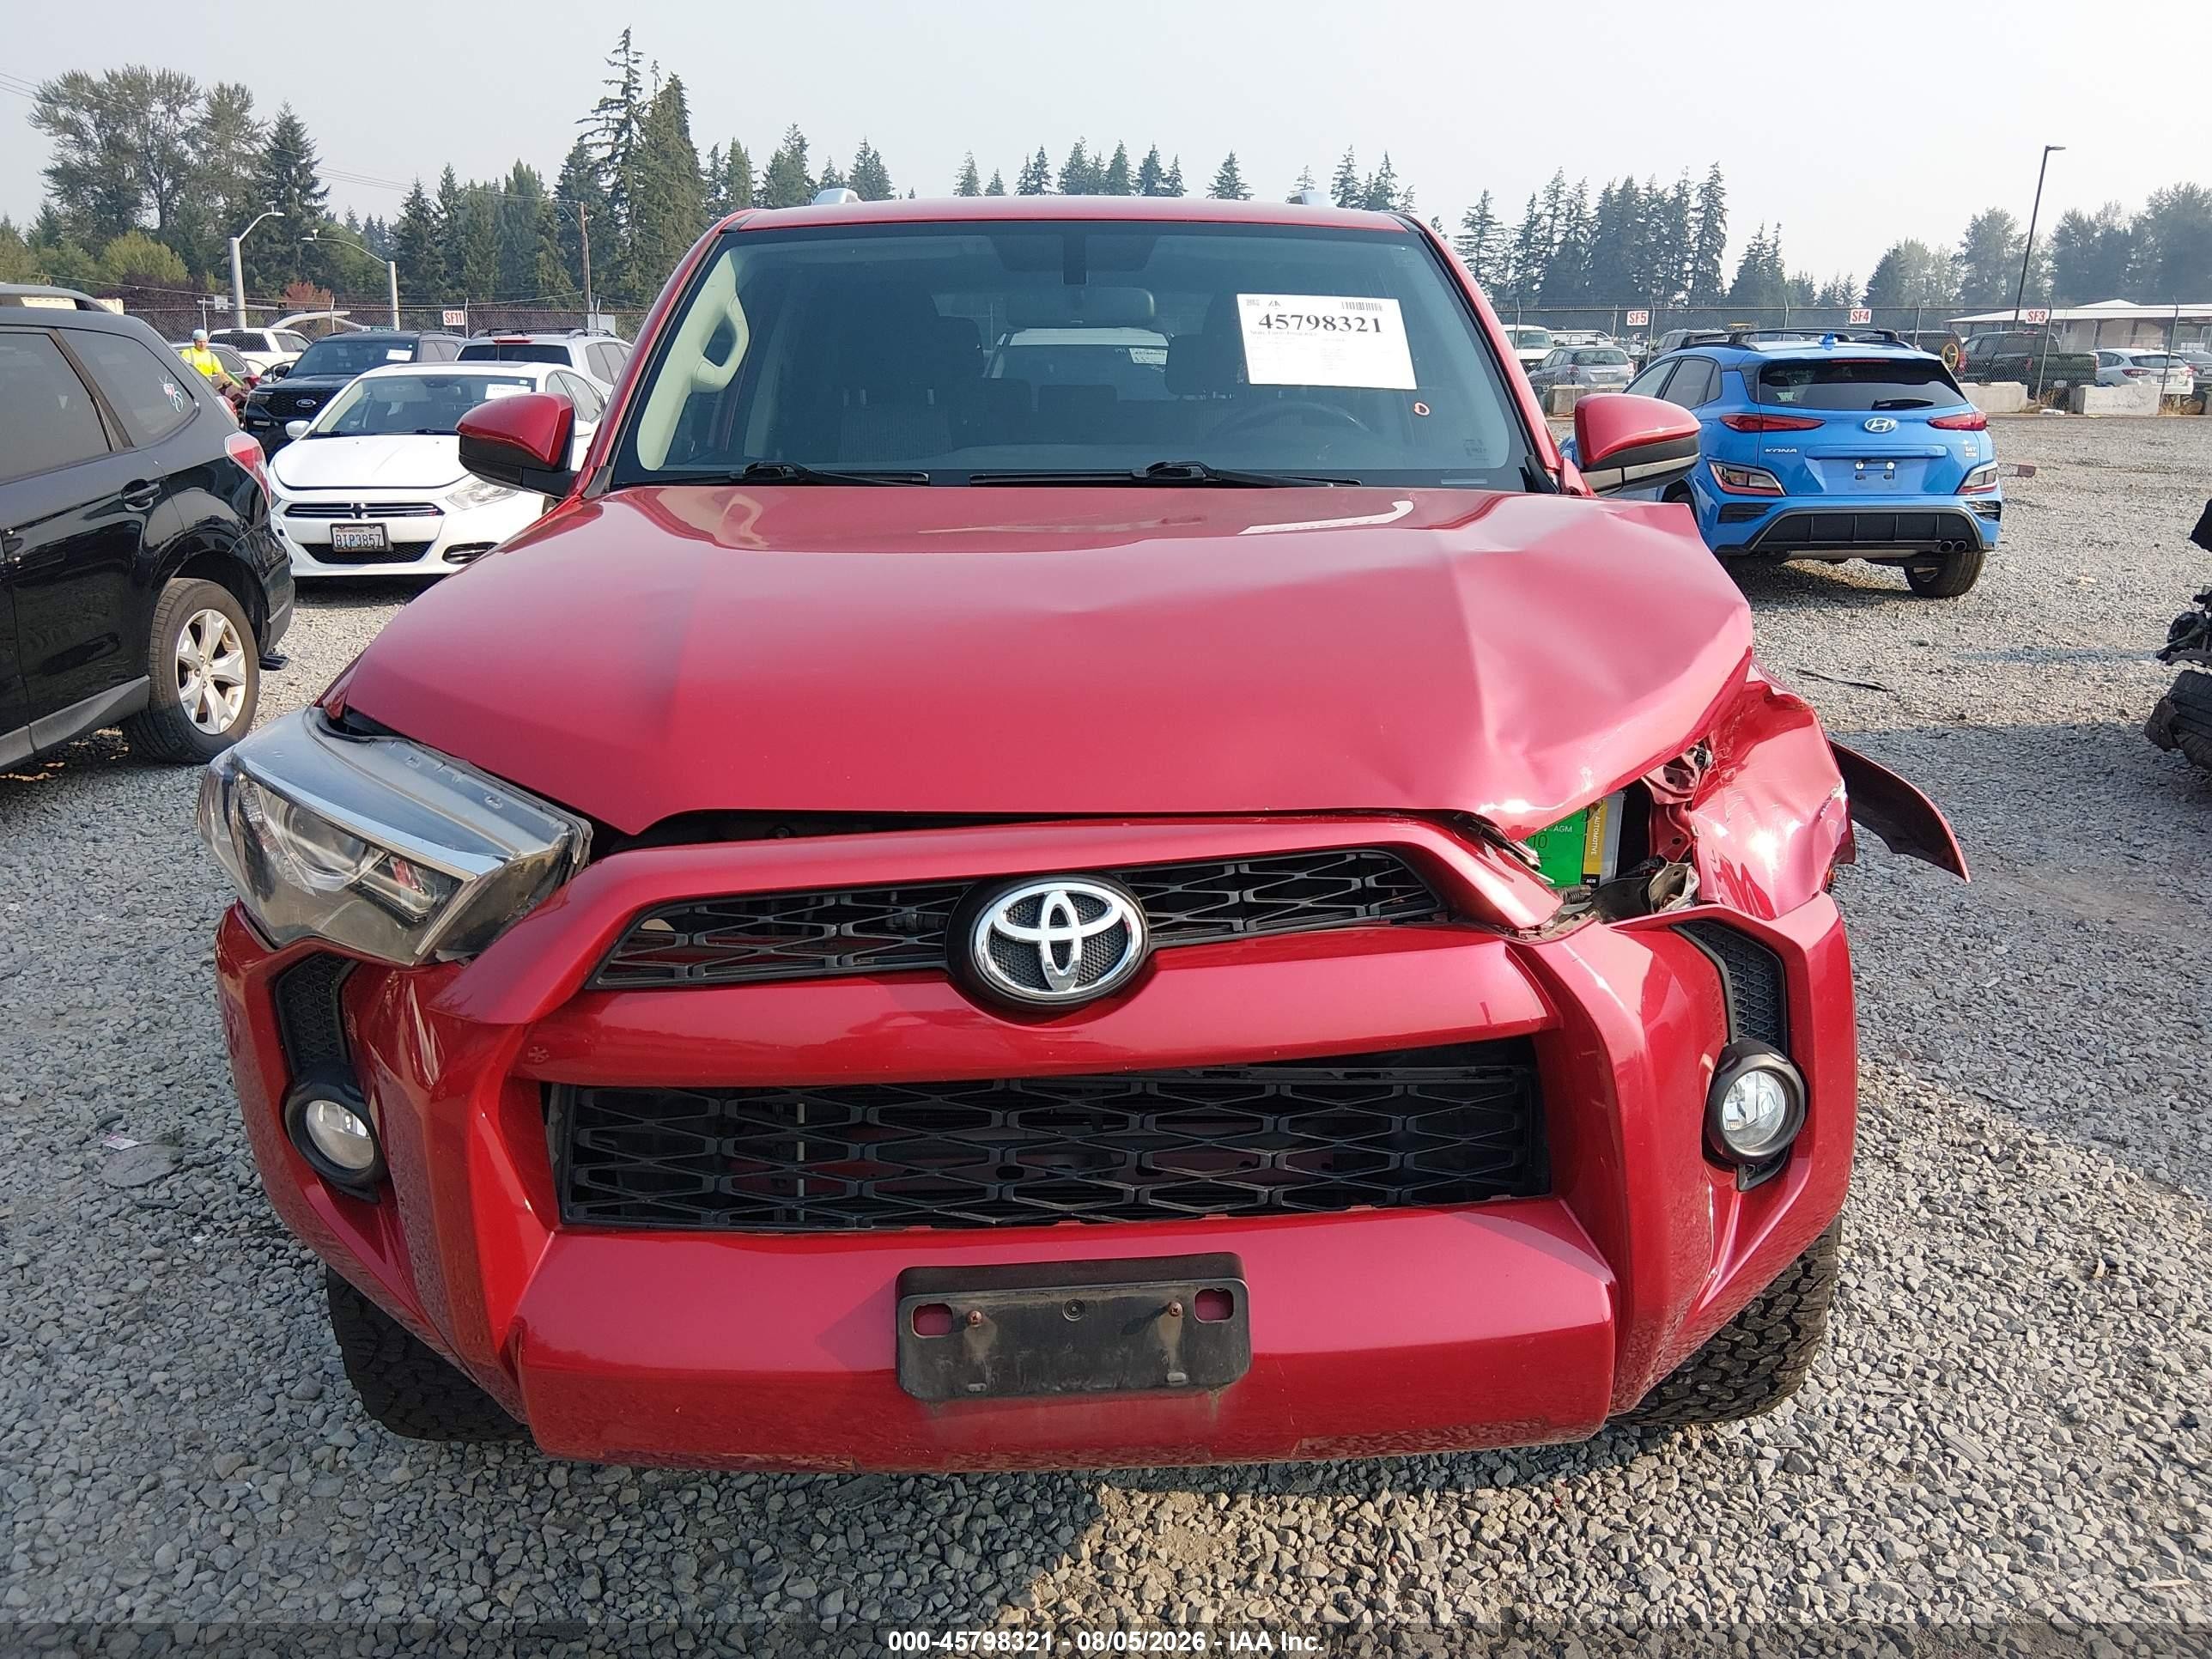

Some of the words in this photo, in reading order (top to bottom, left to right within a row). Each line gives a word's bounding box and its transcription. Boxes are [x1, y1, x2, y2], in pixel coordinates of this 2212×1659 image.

[445, 312, 463, 324] SF11
[1629, 312, 1647, 324] SF5
[1851, 310, 1869, 322] SF4
[2027, 310, 2045, 322] SF3
[1258, 313, 1383, 333] 45798321
[1553, 824, 1573, 833] AGM
[1590, 815, 1601, 857] AUTOMOTIVE
